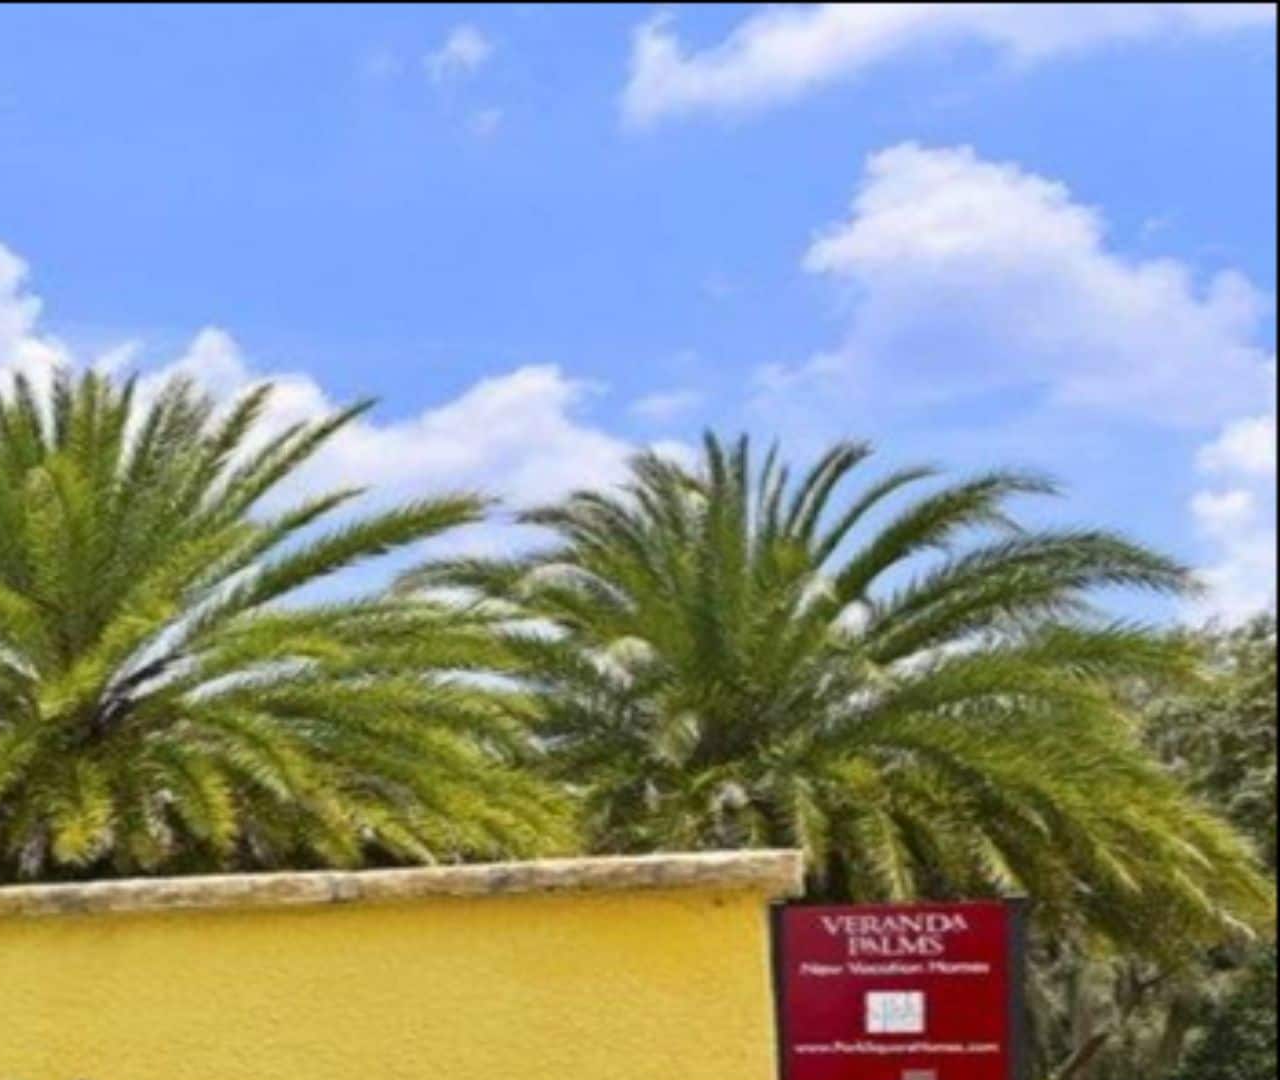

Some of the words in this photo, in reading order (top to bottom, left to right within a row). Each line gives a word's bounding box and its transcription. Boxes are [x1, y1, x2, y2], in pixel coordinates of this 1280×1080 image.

[820, 913, 968, 934] VERANDA
[848, 935, 945, 956] PALMS
[799, 962, 843, 975] New
[848, 962, 923, 974] Vacation
[928, 961, 990, 974] Homes
